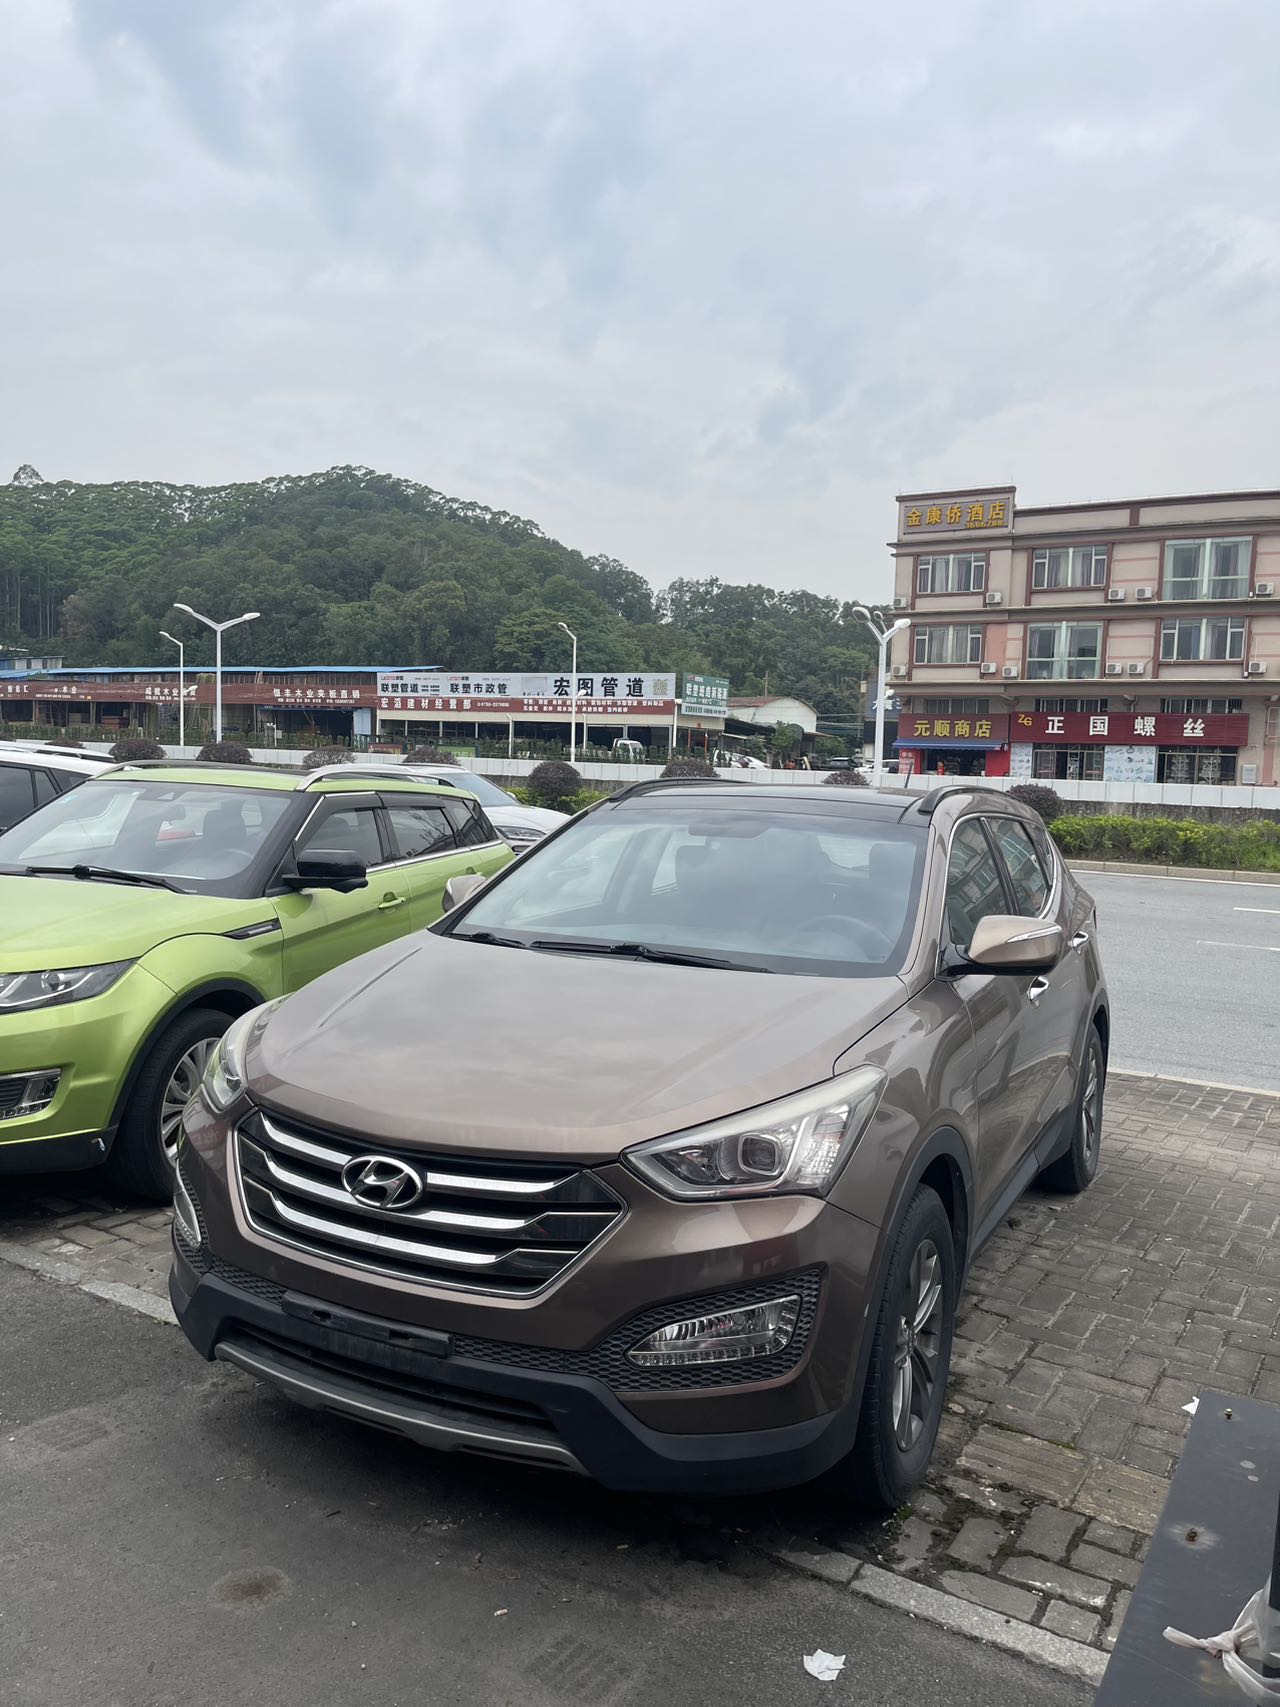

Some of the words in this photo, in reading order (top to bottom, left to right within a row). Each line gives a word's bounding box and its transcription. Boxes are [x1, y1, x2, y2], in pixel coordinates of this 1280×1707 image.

[906, 502, 1006, 527] 金康侨酒店
[381, 683, 419, 693] 联塑管道
[450, 683, 508, 694] 联塑市政管
[553, 677, 645, 699] 宏图管道
[914, 719, 992, 738] 元顺商店
[1045, 715, 1205, 737] 正国螺丝
